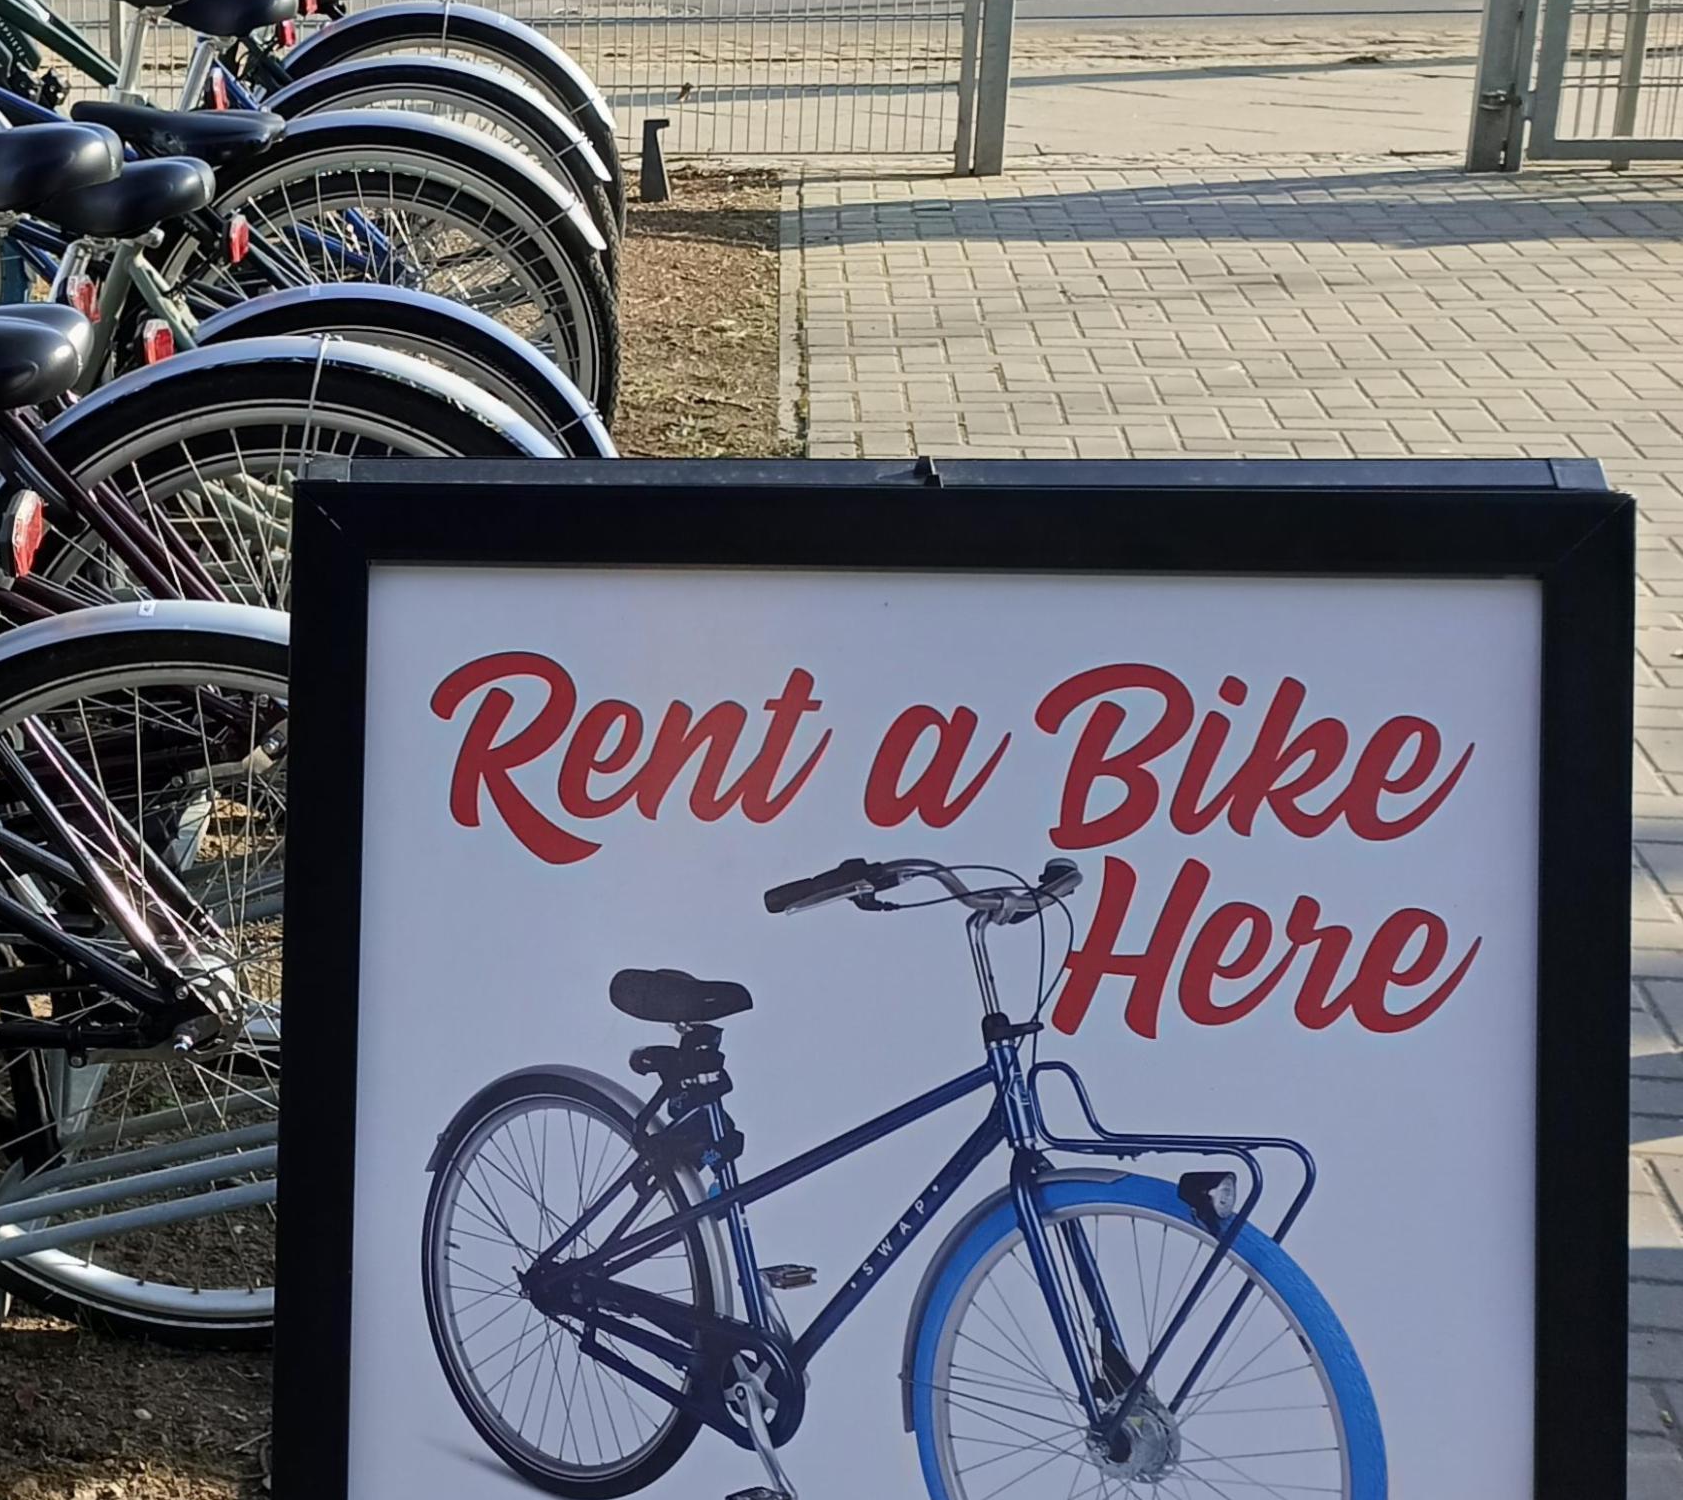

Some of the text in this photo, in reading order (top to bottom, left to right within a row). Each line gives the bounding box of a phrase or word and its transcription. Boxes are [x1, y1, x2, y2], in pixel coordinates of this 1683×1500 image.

[430, 651, 1475, 864] Rent a Bike
[1051, 855, 1482, 1039] Here
[861, 1199, 926, 1276] SWAP
